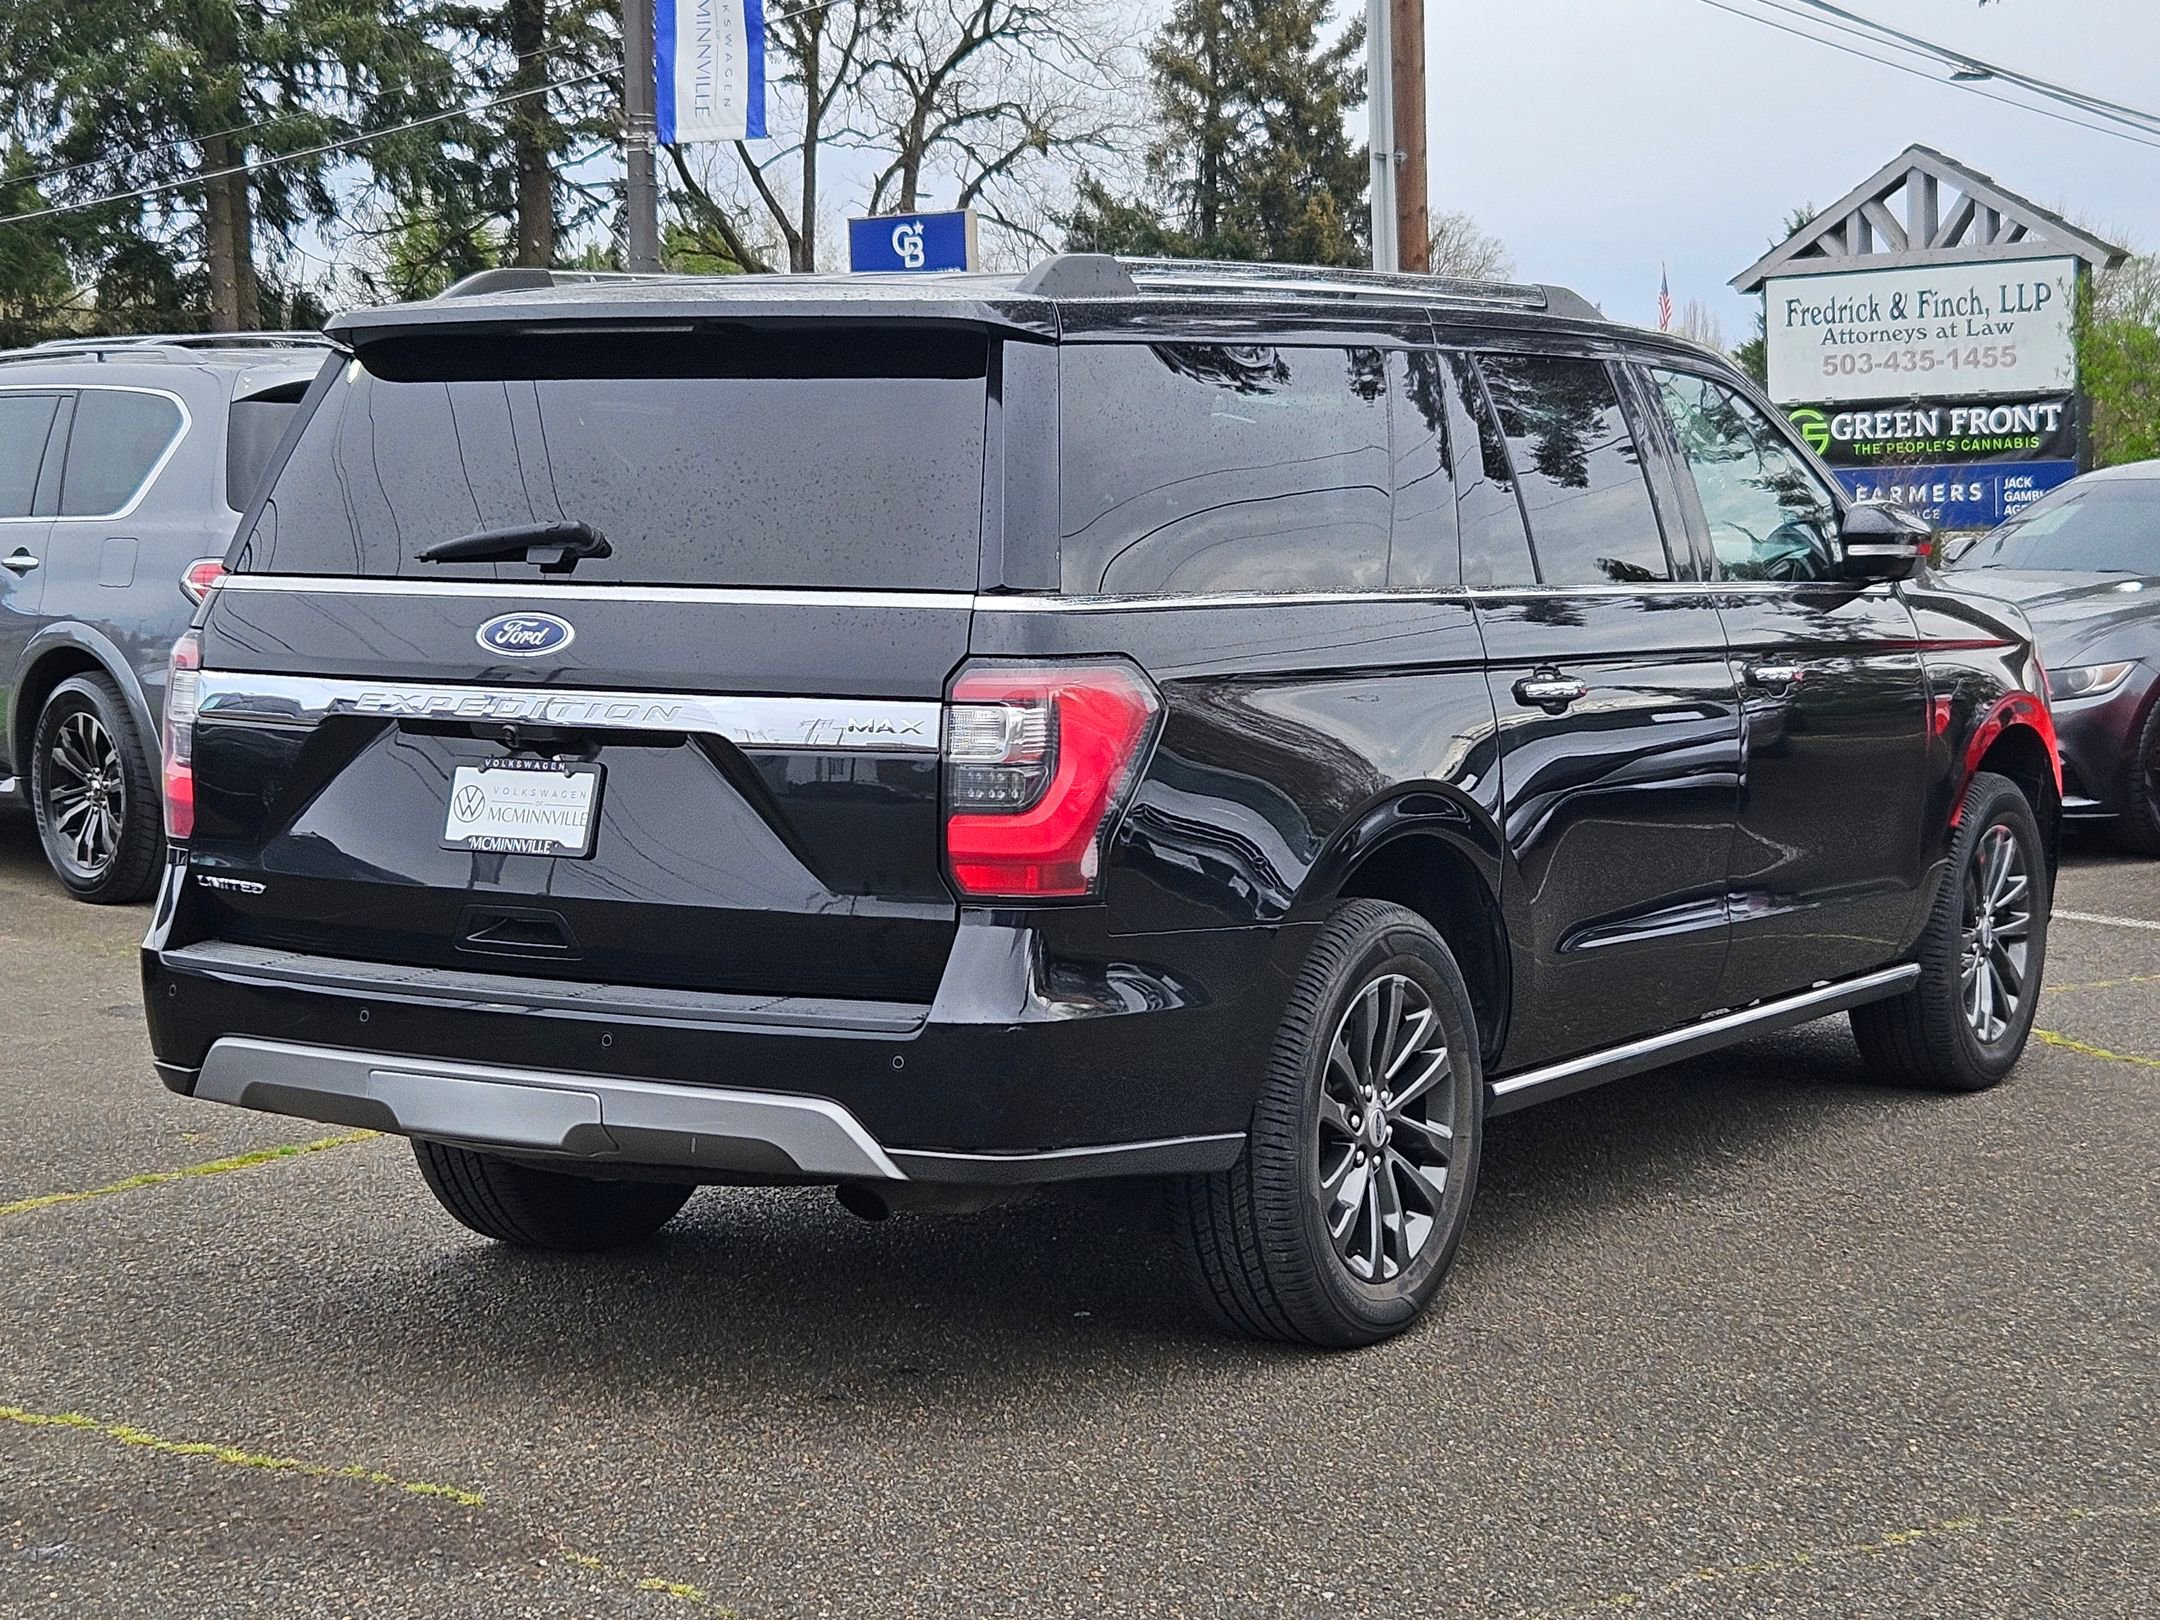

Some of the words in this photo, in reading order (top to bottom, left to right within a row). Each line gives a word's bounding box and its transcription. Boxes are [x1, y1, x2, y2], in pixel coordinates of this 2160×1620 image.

[1785, 295, 1882, 327] Fredrick
[1889, 291, 1908, 321] &
[1916, 285, 1990, 320] Finch,
[1999, 282, 2051, 314] LLP
[1820, 325, 1928, 346] Attorneys
[1935, 322, 1958, 339] at
[1966, 318, 2015, 337] Law
[1822, 345, 2018, 377] 503-435-1455
[1831, 410, 1939, 440] GREEN
[1950, 403, 2062, 437] FRONT
[1853, 443, 1880, 456] THE
[1887, 439, 1956, 454] PEOPLE'S
[1960, 436, 2040, 450] CANNABIS
[1856, 482, 1983, 503] FARMERS
[2003, 475, 2033, 489] JACK
[495, 620, 550, 646] Ford
[352, 691, 684, 723] EXPEDITION
[847, 717, 925, 735] MAX
[485, 759, 566, 771] VOLKSWAGEN
[493, 786, 587, 800] VOLKSWAGEN
[487, 806, 589, 827] MCMINNVILLE
